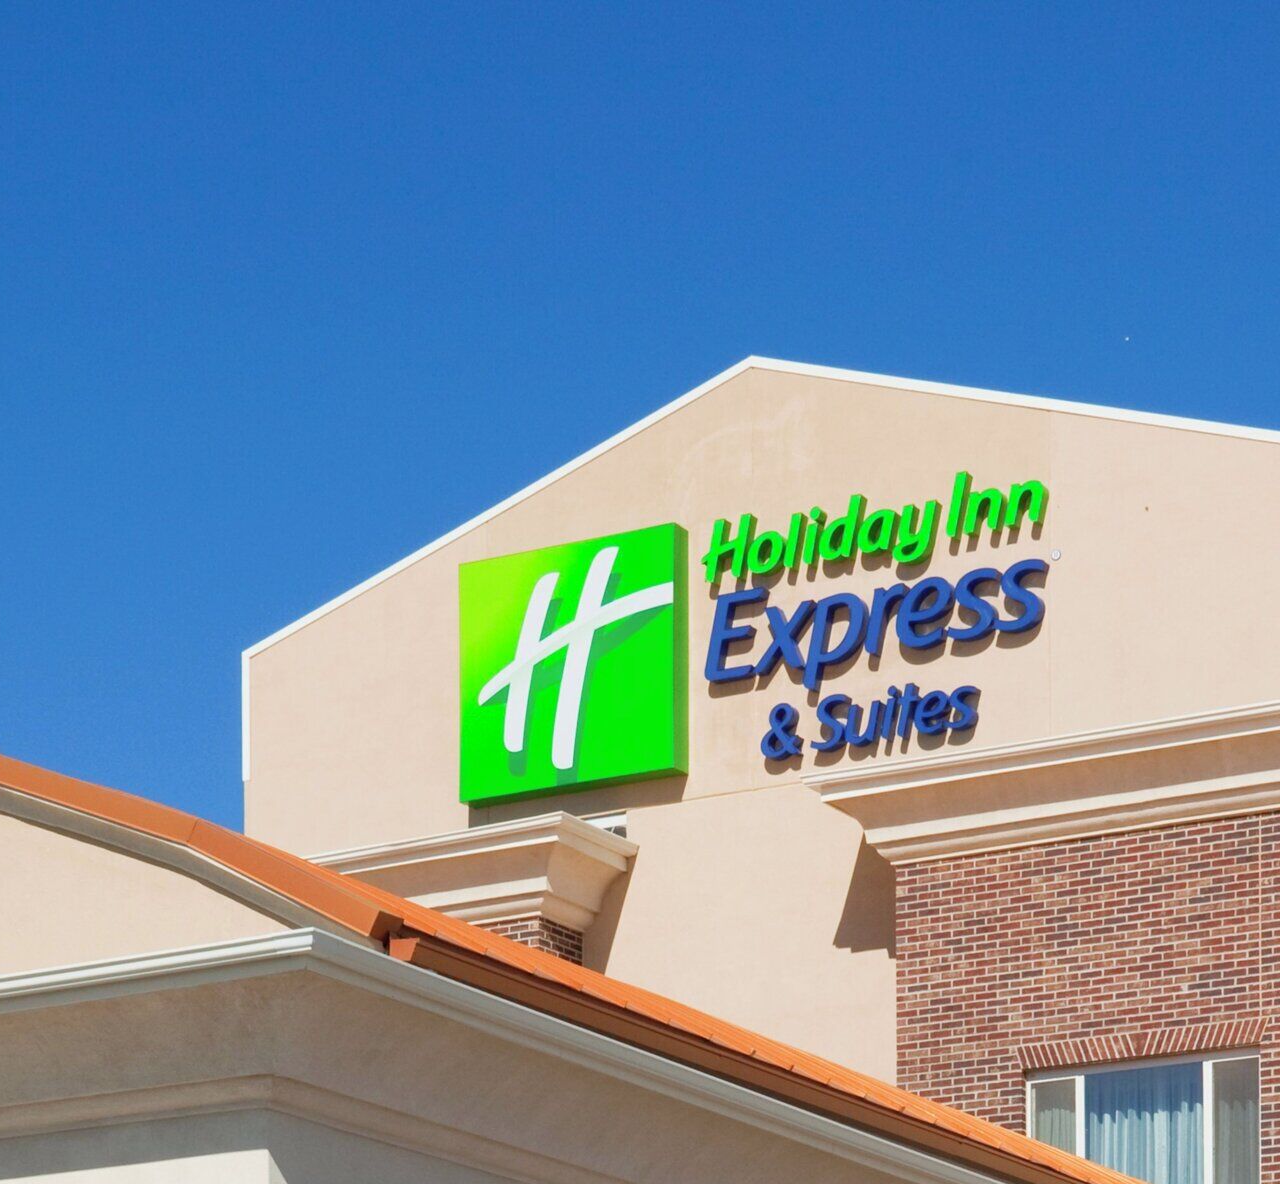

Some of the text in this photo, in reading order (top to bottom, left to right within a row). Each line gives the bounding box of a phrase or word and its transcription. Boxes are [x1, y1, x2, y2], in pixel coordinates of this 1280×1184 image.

[701, 470, 1049, 583] Holiday Inn
[704, 557, 1048, 692] Express
[760, 681, 982, 760] & Suites
